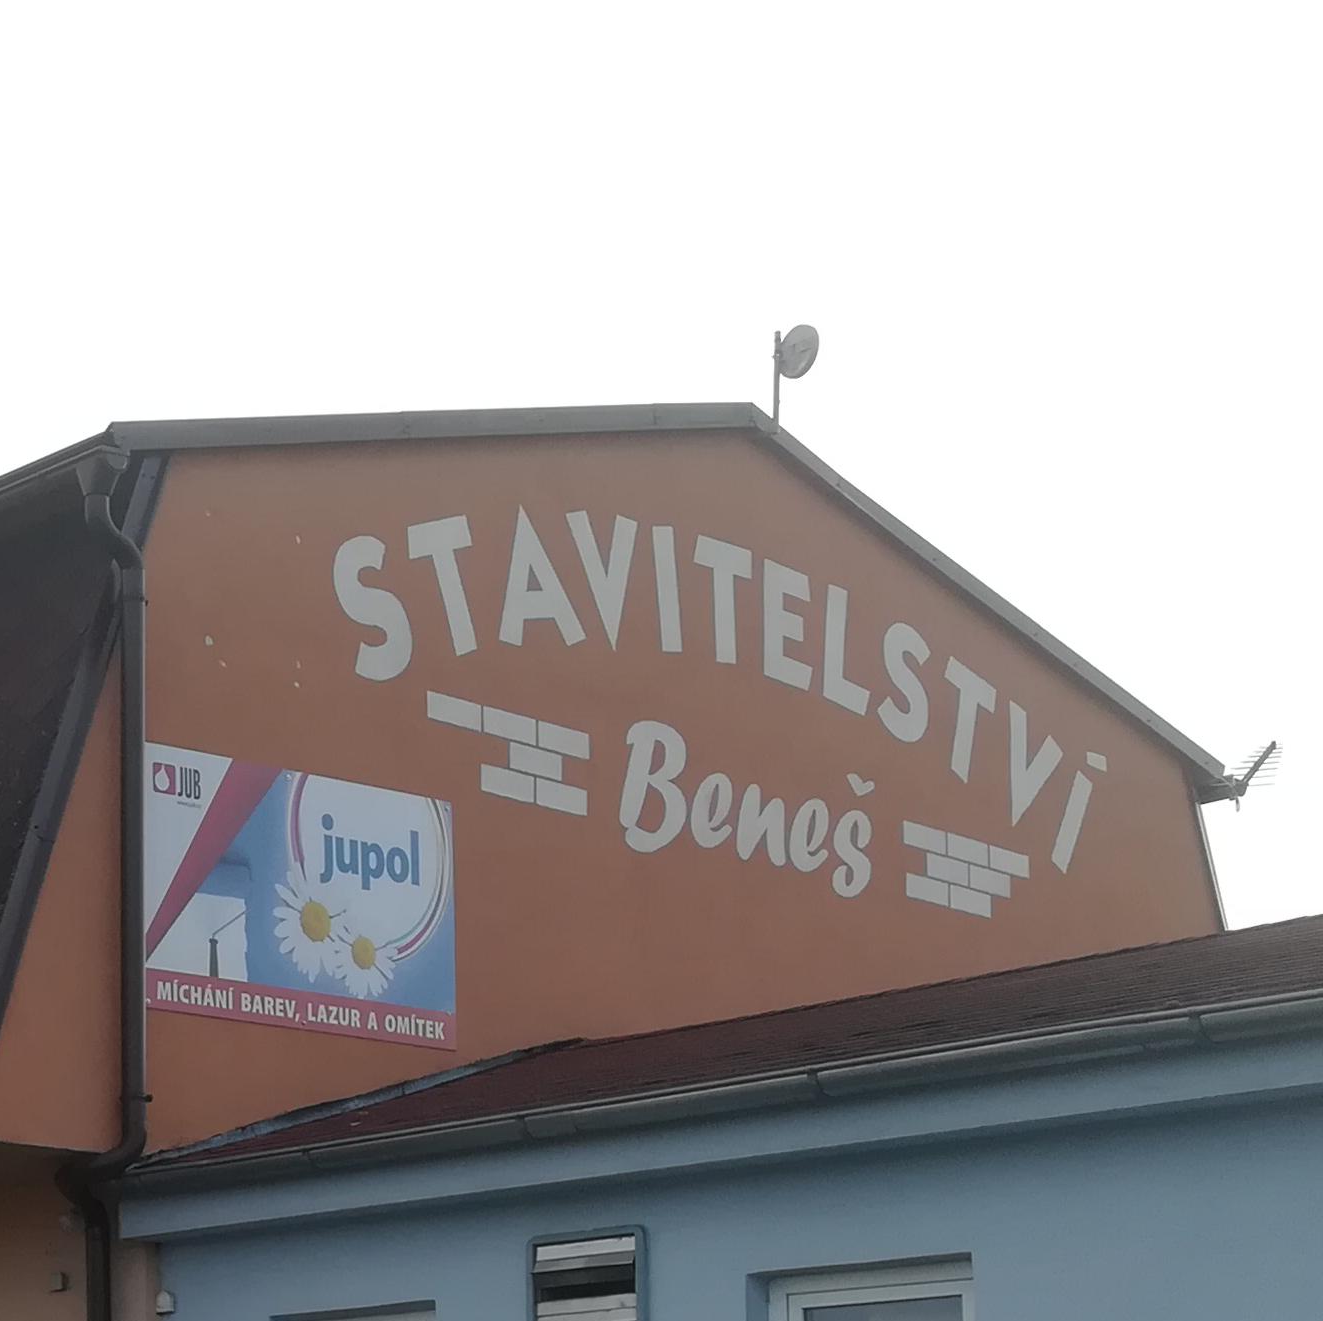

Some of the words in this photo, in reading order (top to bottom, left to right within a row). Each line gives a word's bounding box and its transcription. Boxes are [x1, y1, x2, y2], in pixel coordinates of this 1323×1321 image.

[330, 504, 1108, 877] STAVITELSTVÍ
[177, 766, 201, 800] JUB
[618, 719, 873, 899] Beneš
[319, 813, 421, 890] jupol
[156, 978, 234, 1010] MÍCHÁNÍ
[240, 992, 301, 1023] BAREV,
[306, 1002, 361, 1029] LAZUR
[366, 1011, 378, 1031] A
[384, 1013, 445, 1041] OMÍTEK
